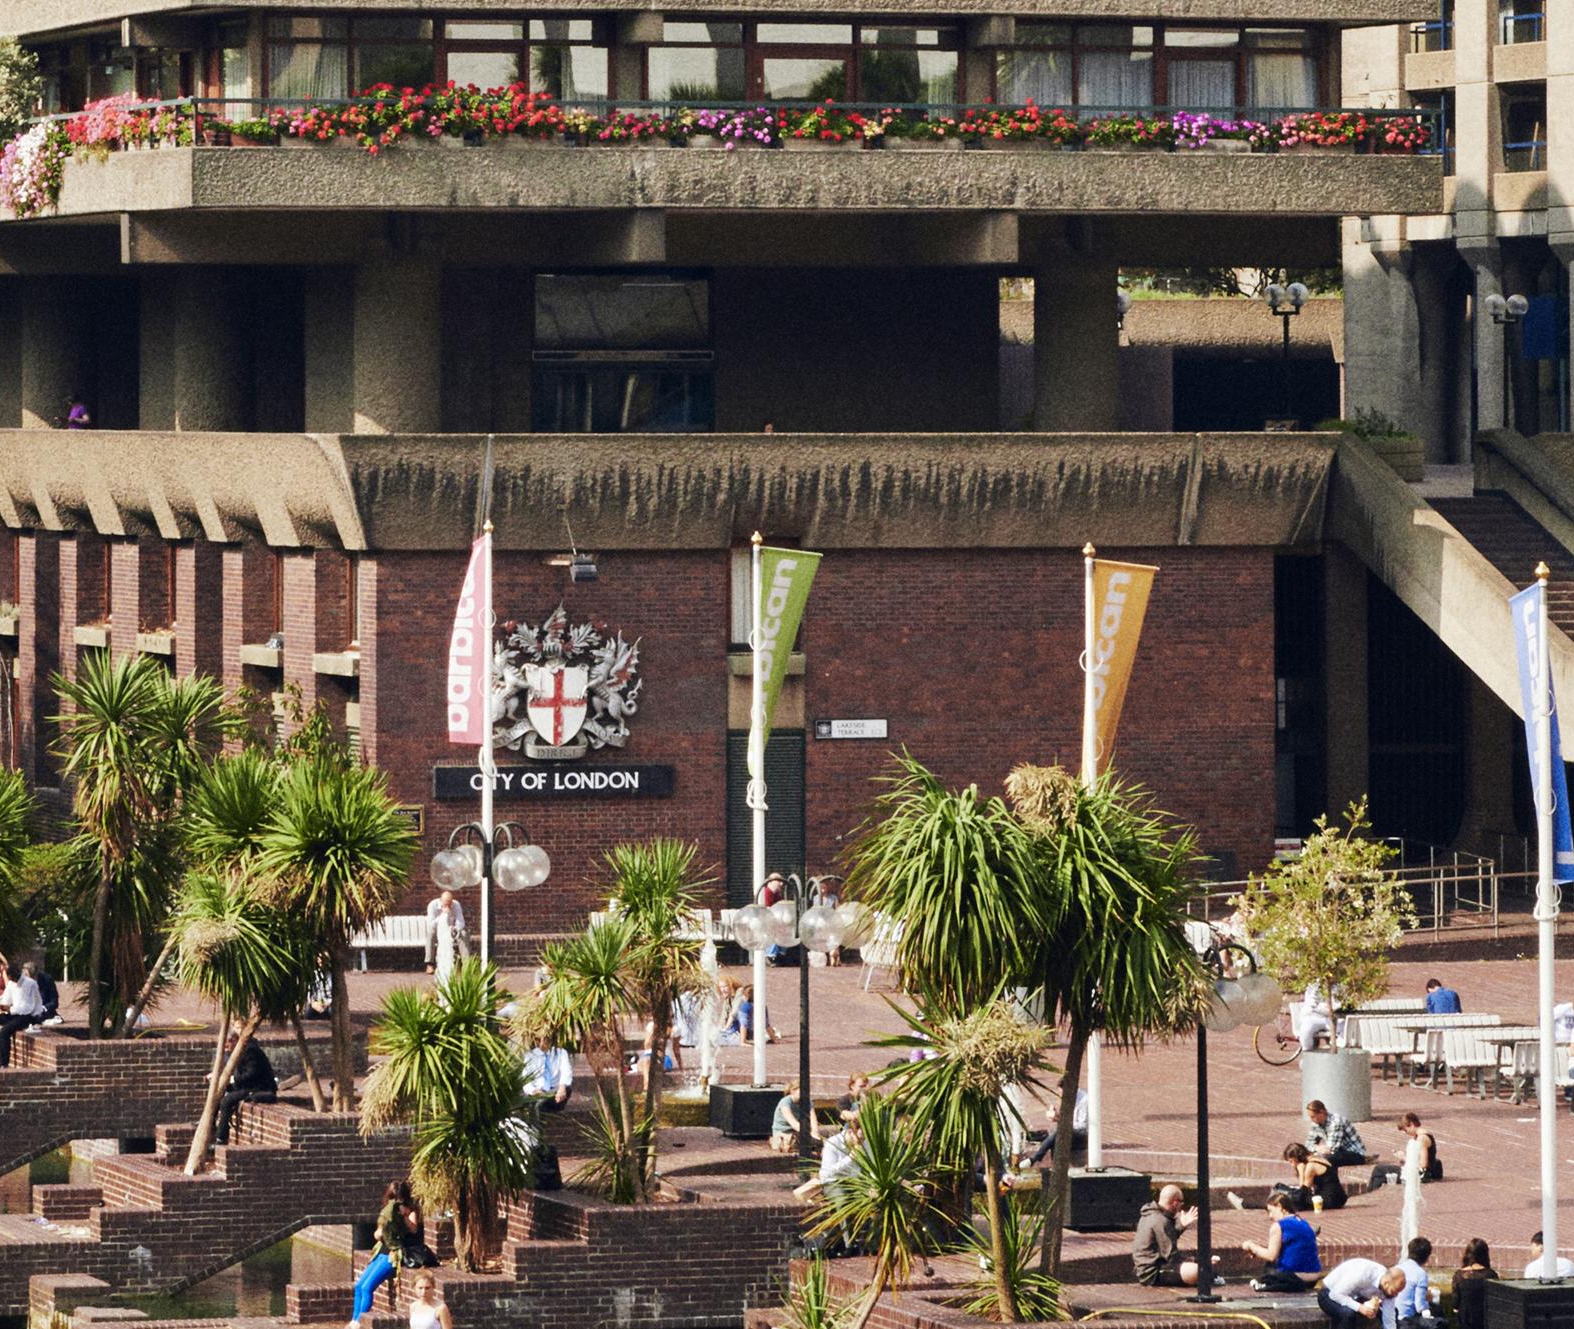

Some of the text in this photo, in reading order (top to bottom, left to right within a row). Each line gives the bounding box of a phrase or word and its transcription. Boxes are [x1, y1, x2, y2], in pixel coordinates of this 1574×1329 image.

[448, 548, 476, 732] barbica
[759, 559, 797, 704] bican
[470, 772, 639, 790] CTY OF LONDON
